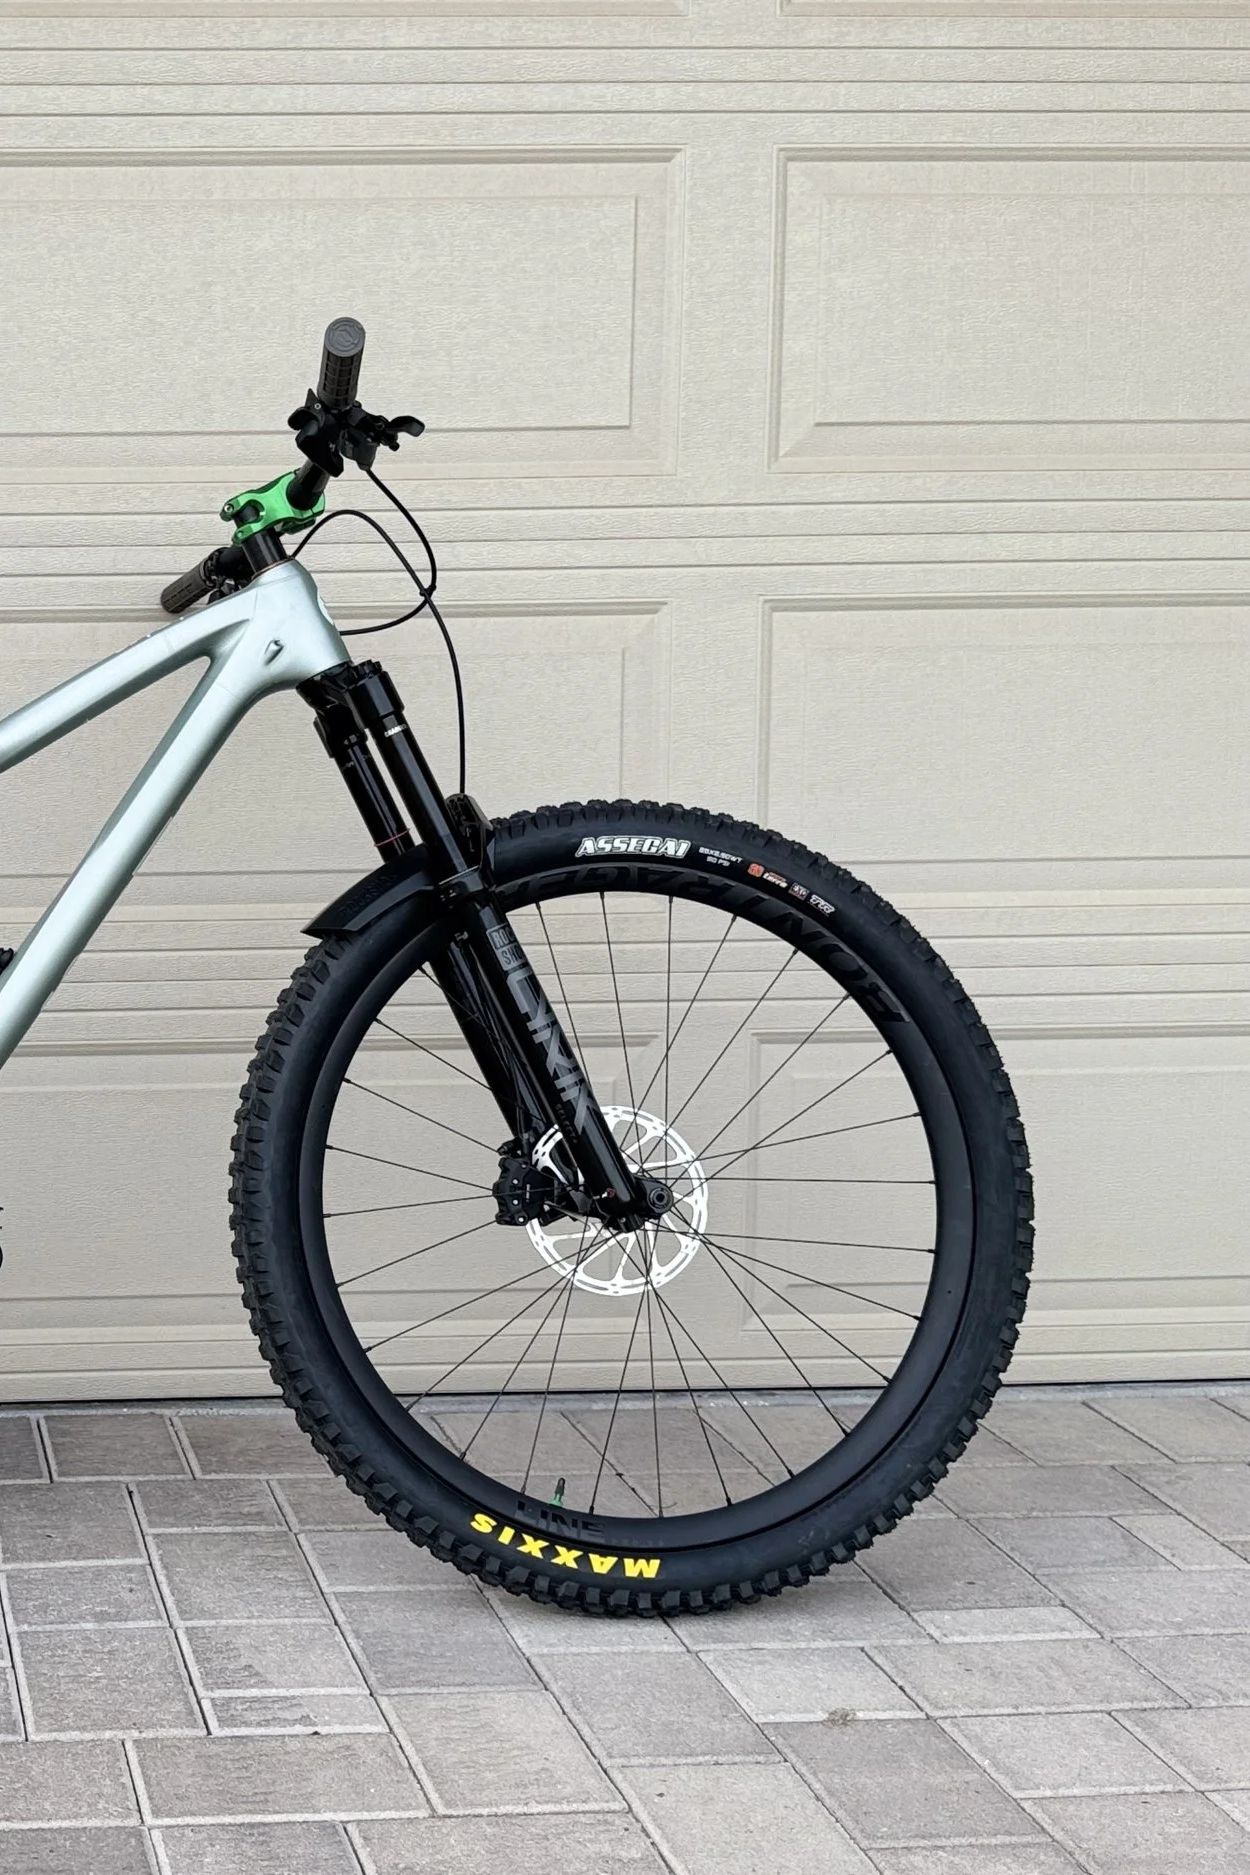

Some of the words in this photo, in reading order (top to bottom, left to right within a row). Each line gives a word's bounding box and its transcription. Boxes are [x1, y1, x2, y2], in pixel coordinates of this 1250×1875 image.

[575, 836, 692, 859] ASSEGAI
[490, 925, 517, 949] ROC
[501, 944, 525, 965] SHO
[506, 966, 600, 1137] LYRIK
[514, 1500, 606, 1543] LINE
[470, 1513, 661, 1578] MAXXIS
